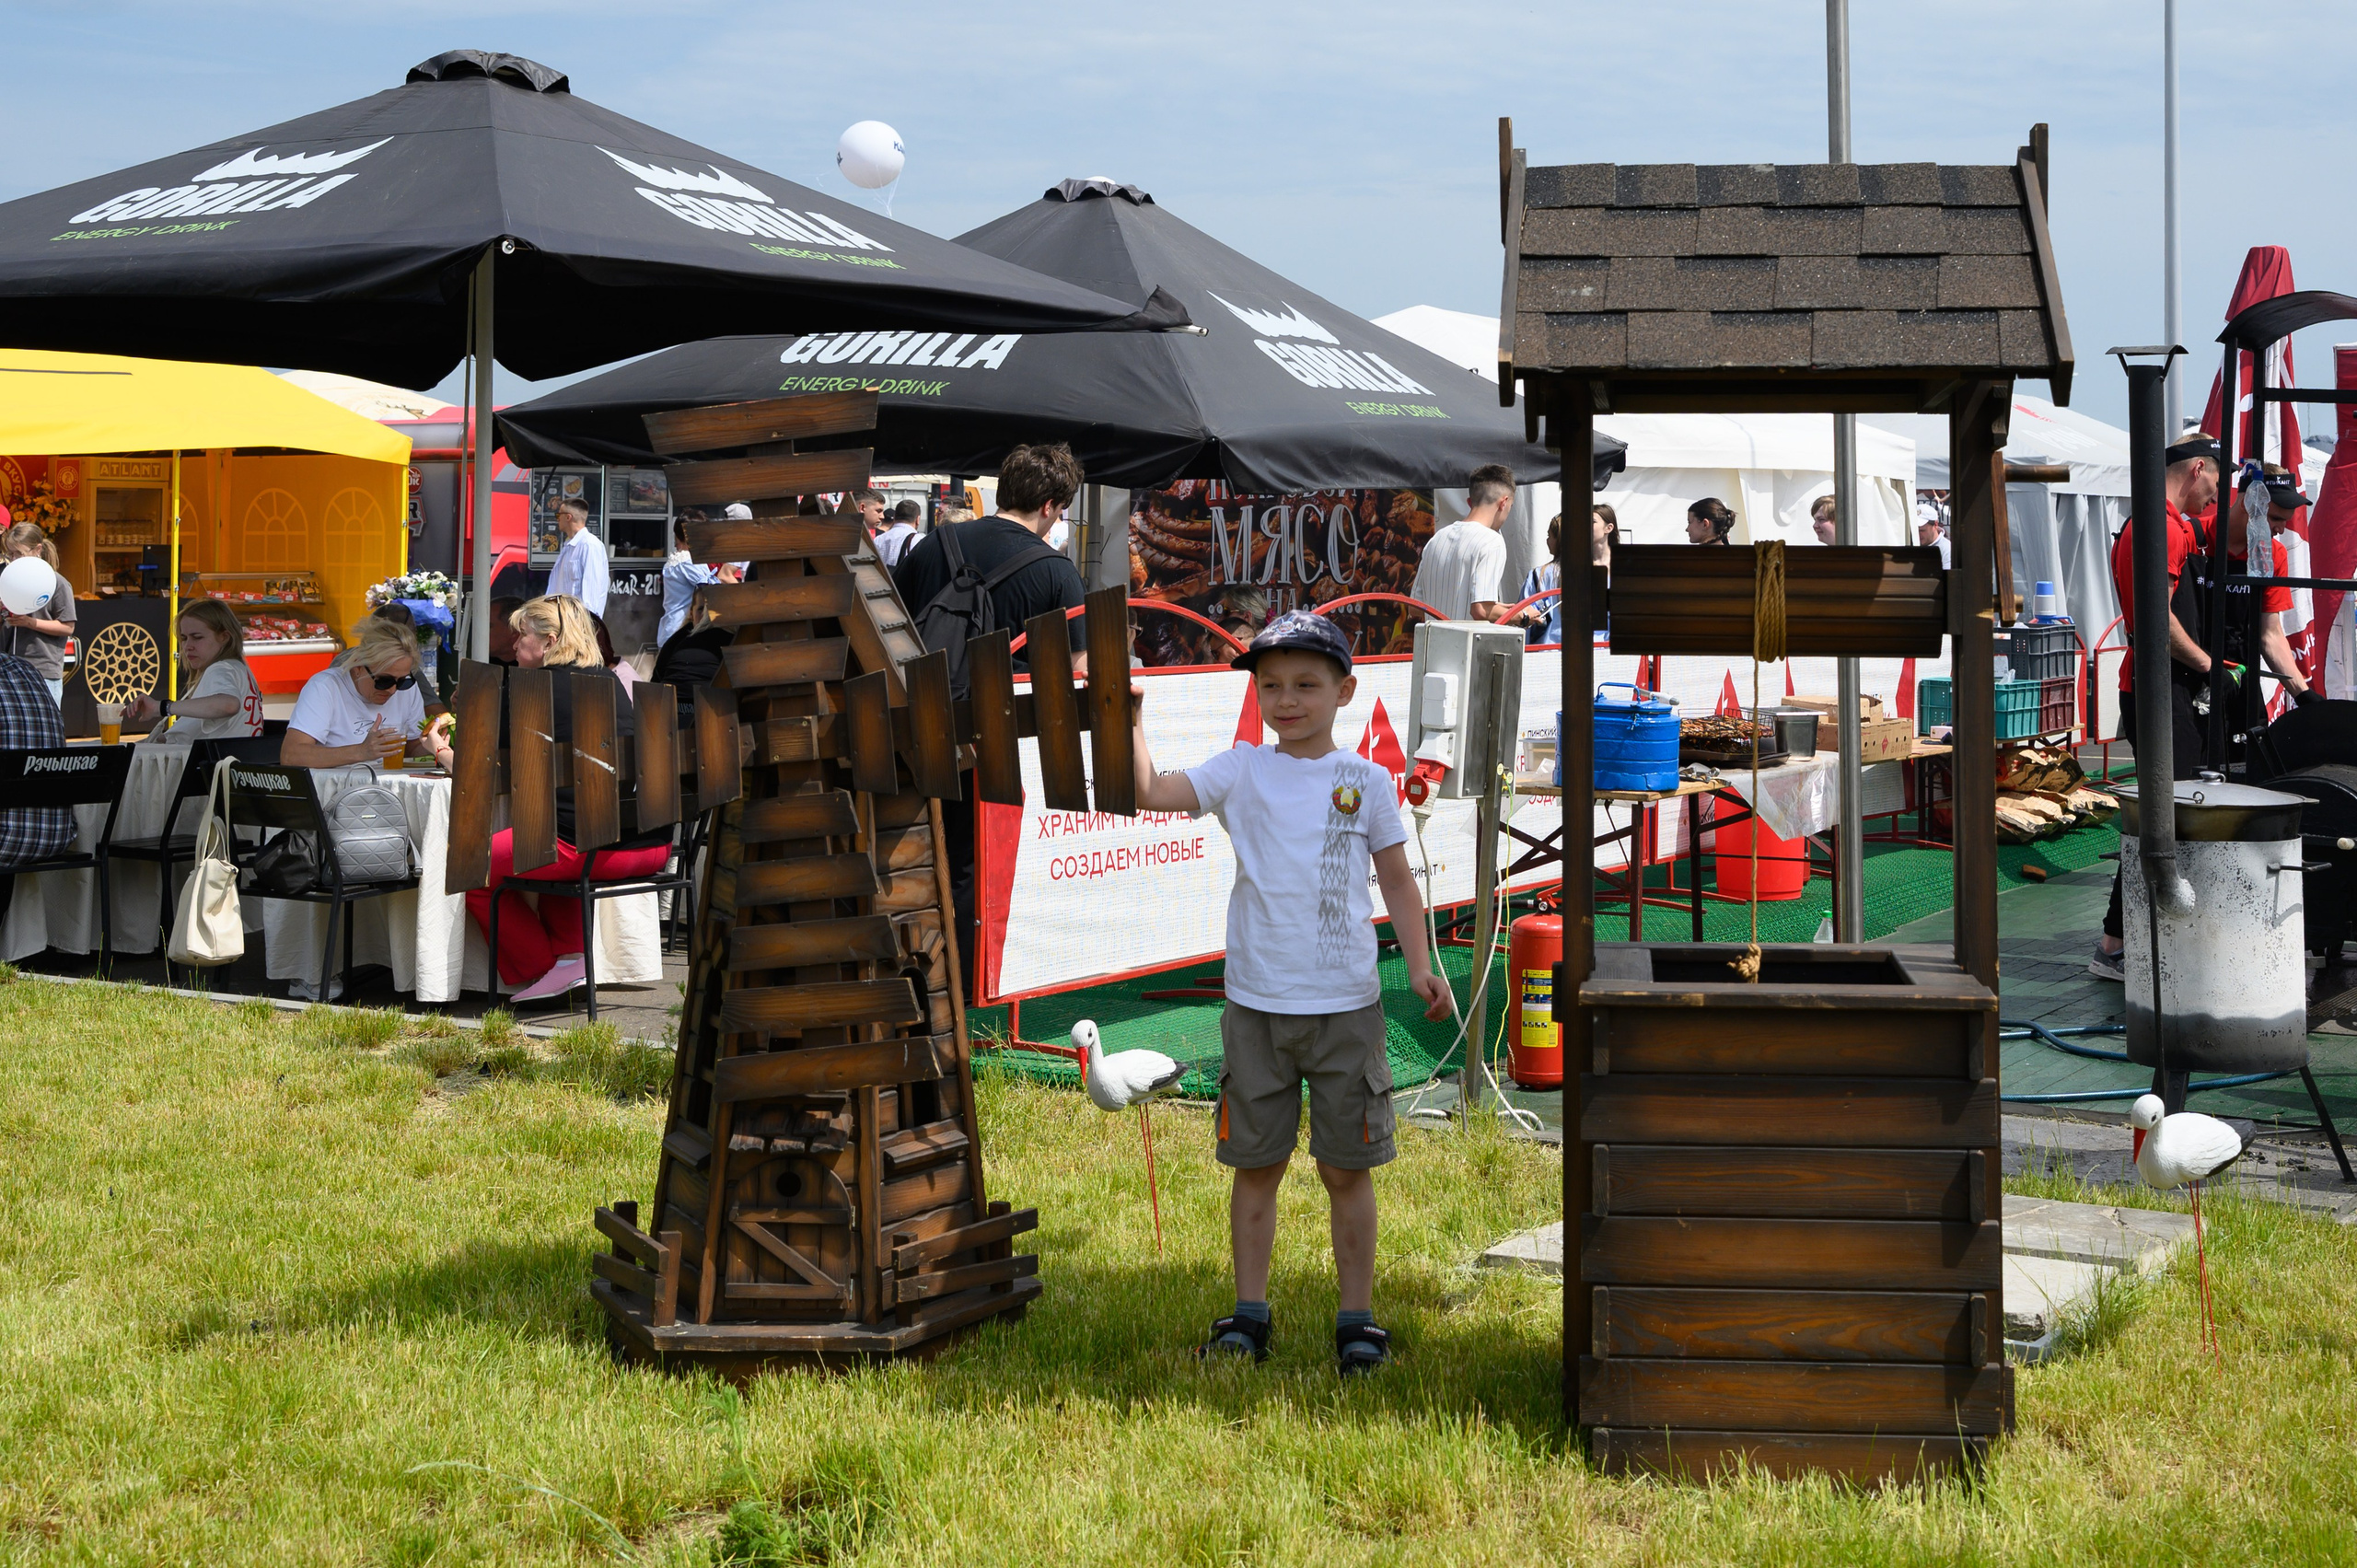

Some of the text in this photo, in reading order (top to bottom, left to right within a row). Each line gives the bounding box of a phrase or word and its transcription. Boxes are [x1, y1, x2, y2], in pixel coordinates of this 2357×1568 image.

[68, 172, 359, 224] GORILLA
[50, 220, 241, 241] ENERGY DRINK
[634, 187, 896, 252] GORILLA
[749, 242, 907, 269] ENERGY DRINK
[780, 331, 1023, 370] GORILLA
[1253, 339, 1436, 396] GORILLA
[779, 376, 951, 396] ENERGY DRINK
[1345, 401, 1452, 419] ENERGY DRINK
[3, 461, 23, 493] ВКУС
[99, 461, 162, 478] ATLANT
[1208, 504, 1361, 586] МЯСО
[608, 574, 640, 597] AKAR
[1527, 726, 1557, 738] ПИНСКИЙ
[23, 755, 99, 775] Рэчыцкае
[230, 768, 292, 791] Рэчыцкае
[1038, 808, 1115, 840] ХРАНИМ
[1051, 837, 1204, 881] СОЗДАЕМ НОВЫЕ
